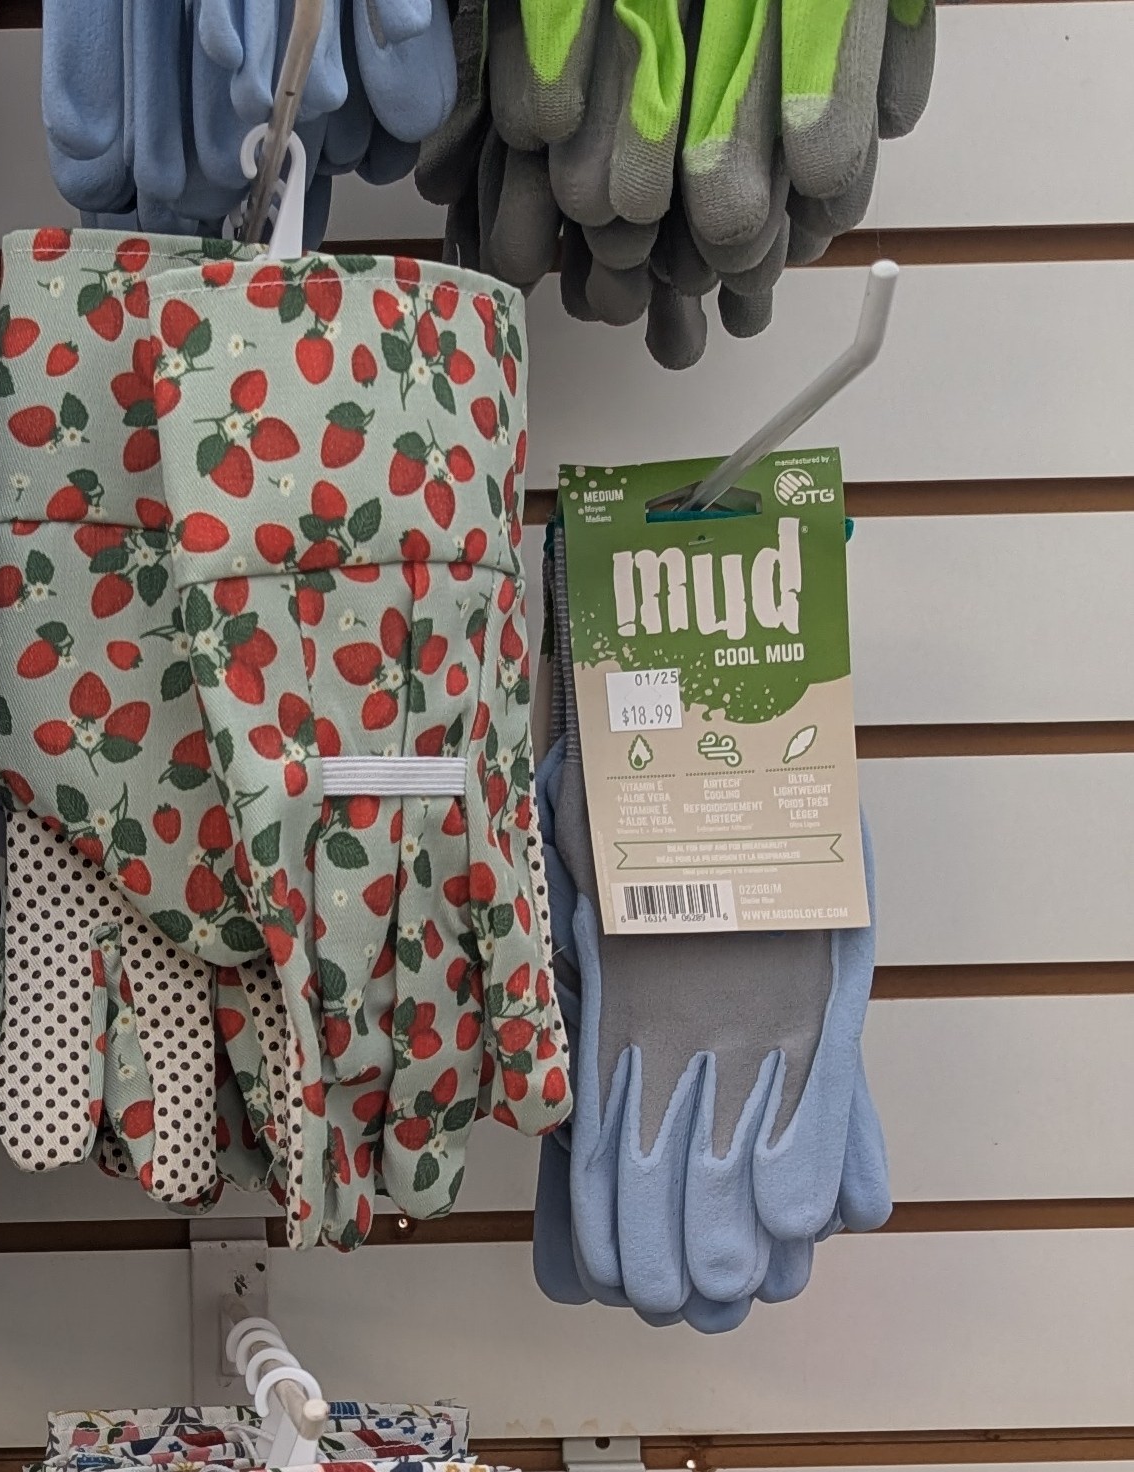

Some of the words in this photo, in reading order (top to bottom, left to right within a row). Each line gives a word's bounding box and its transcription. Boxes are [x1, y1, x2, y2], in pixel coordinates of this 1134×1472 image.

[774, 456, 819, 467] manufactured
[820, 455, 830, 466] by
[583, 489, 625, 503] MEDIUM
[612, 517, 803, 640] mud
[714, 646, 760, 667] COOL
[765, 642, 805, 665] MUD
[634, 669, 679, 687] 01/25
[621, 703, 674, 727] $18.99
[788, 773, 816, 784] ULTRA
[704, 789, 741, 800] COOLING
[772, 783, 832, 797] LIGHTWEIGHT
[620, 914, 627, 923] 6
[722, 912, 729, 921] 6
[741, 907, 848, 920] WWW.MUDGLOVE.COM
